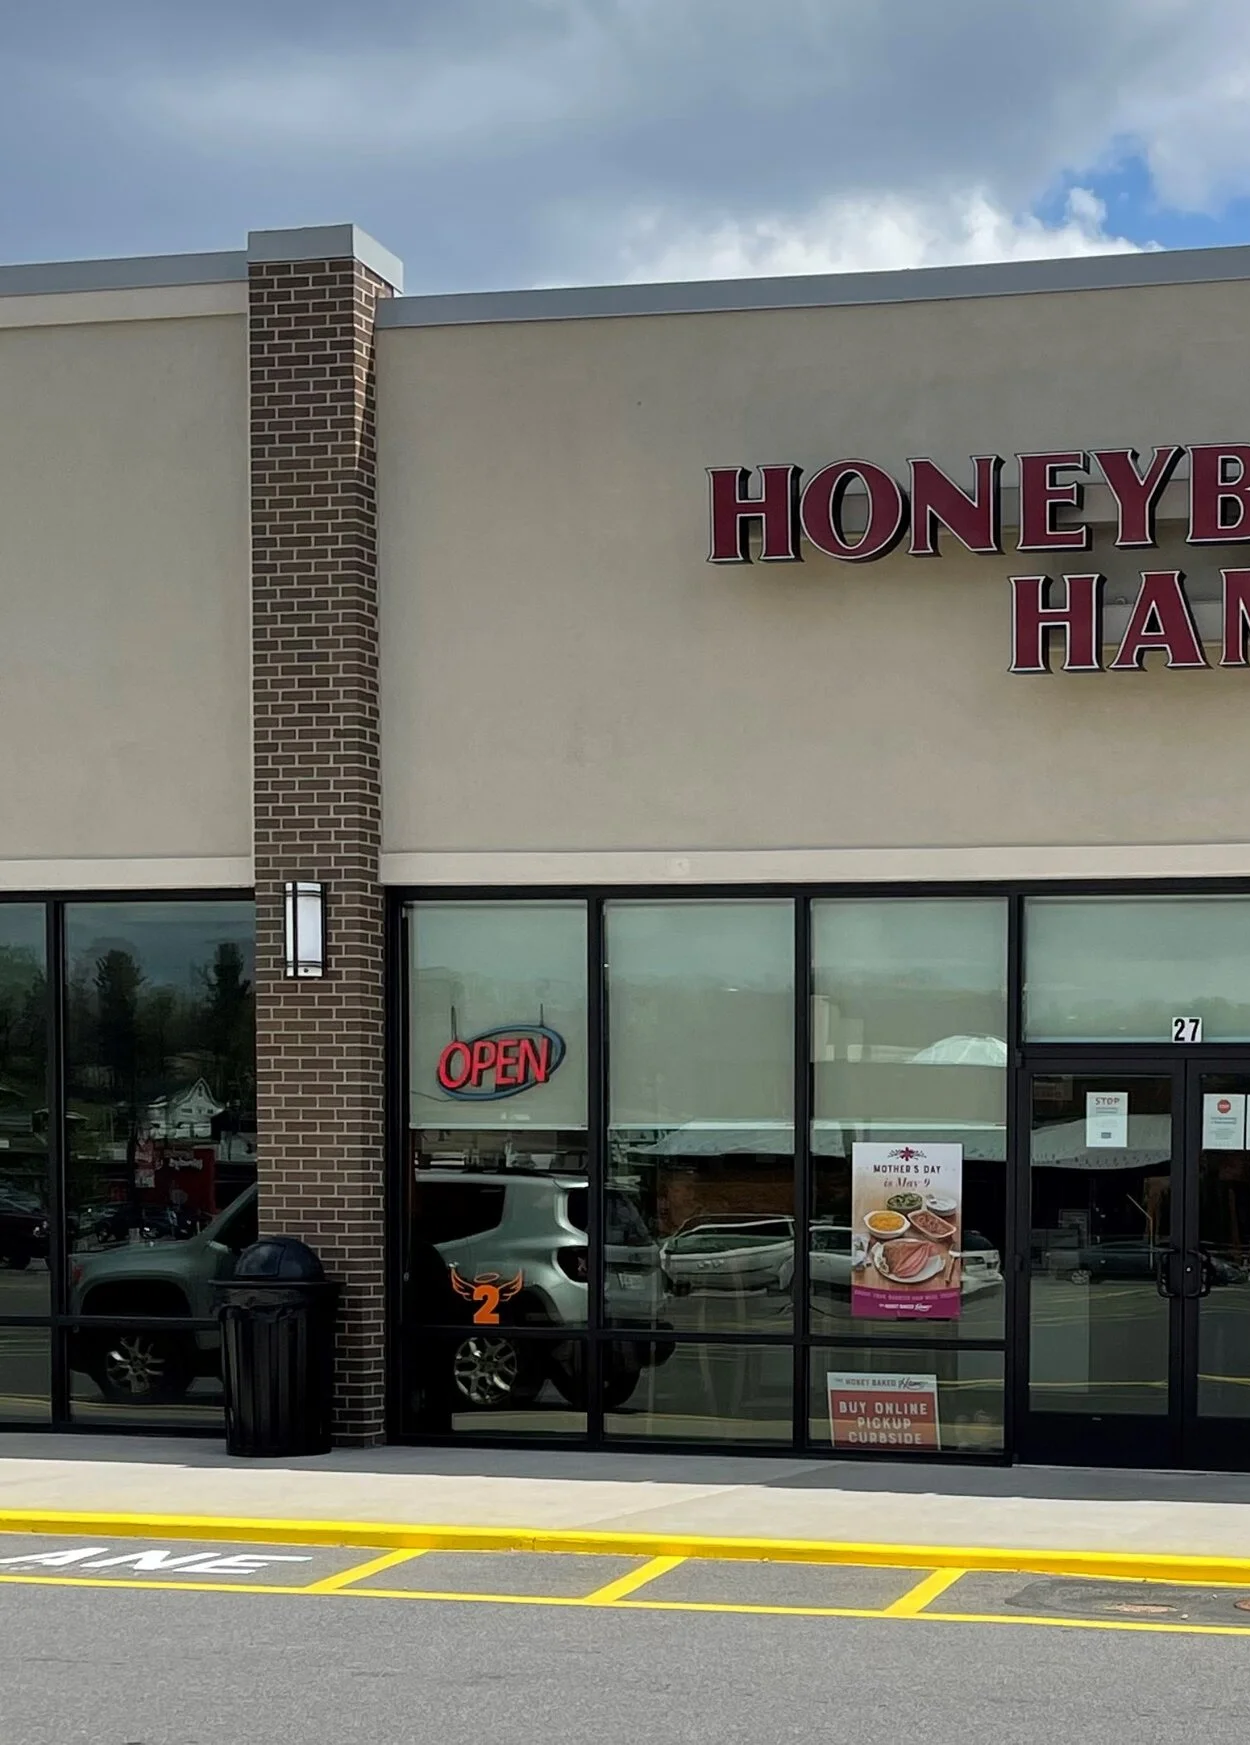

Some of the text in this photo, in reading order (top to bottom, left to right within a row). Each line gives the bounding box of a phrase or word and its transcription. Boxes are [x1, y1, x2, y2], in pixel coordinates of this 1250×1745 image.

[1173, 1018, 1200, 1042] 27
[437, 1035, 550, 1089] OPEN
[1095, 1096, 1120, 1106] STOP
[873, 1164, 941, 1174] MOTHERS DAY
[473, 1284, 500, 1324] 2
[839, 1401, 928, 1416] BUY ONLINE
[857, 1416, 911, 1430] PICKUP
[848, 1431, 923, 1445] CURBSIDE
